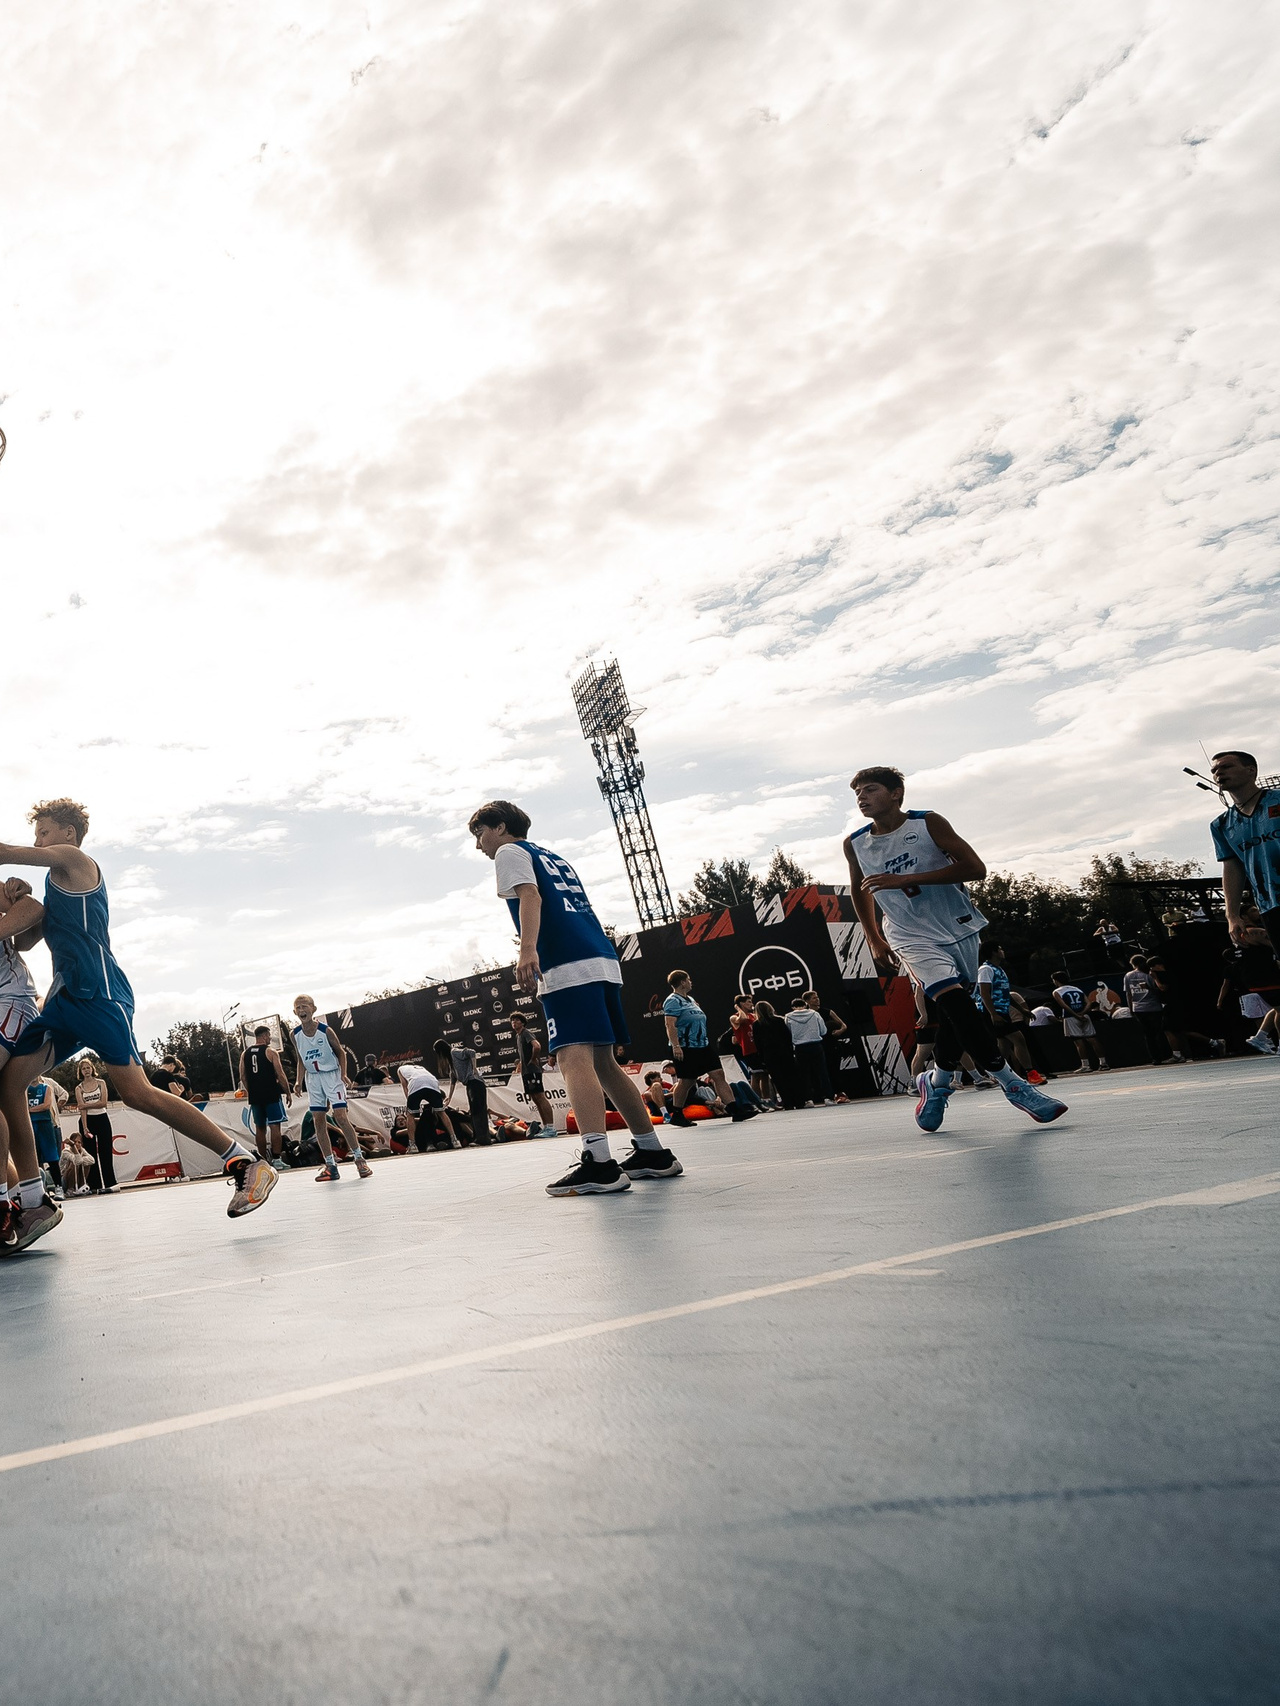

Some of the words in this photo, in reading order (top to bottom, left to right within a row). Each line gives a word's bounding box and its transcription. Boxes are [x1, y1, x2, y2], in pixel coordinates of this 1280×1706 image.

[748, 970, 804, 996] РФБ
[1067, 992, 1082, 1004] 12
[251, 1054, 258, 1074] 9
[515, 1088, 566, 1104] apone
